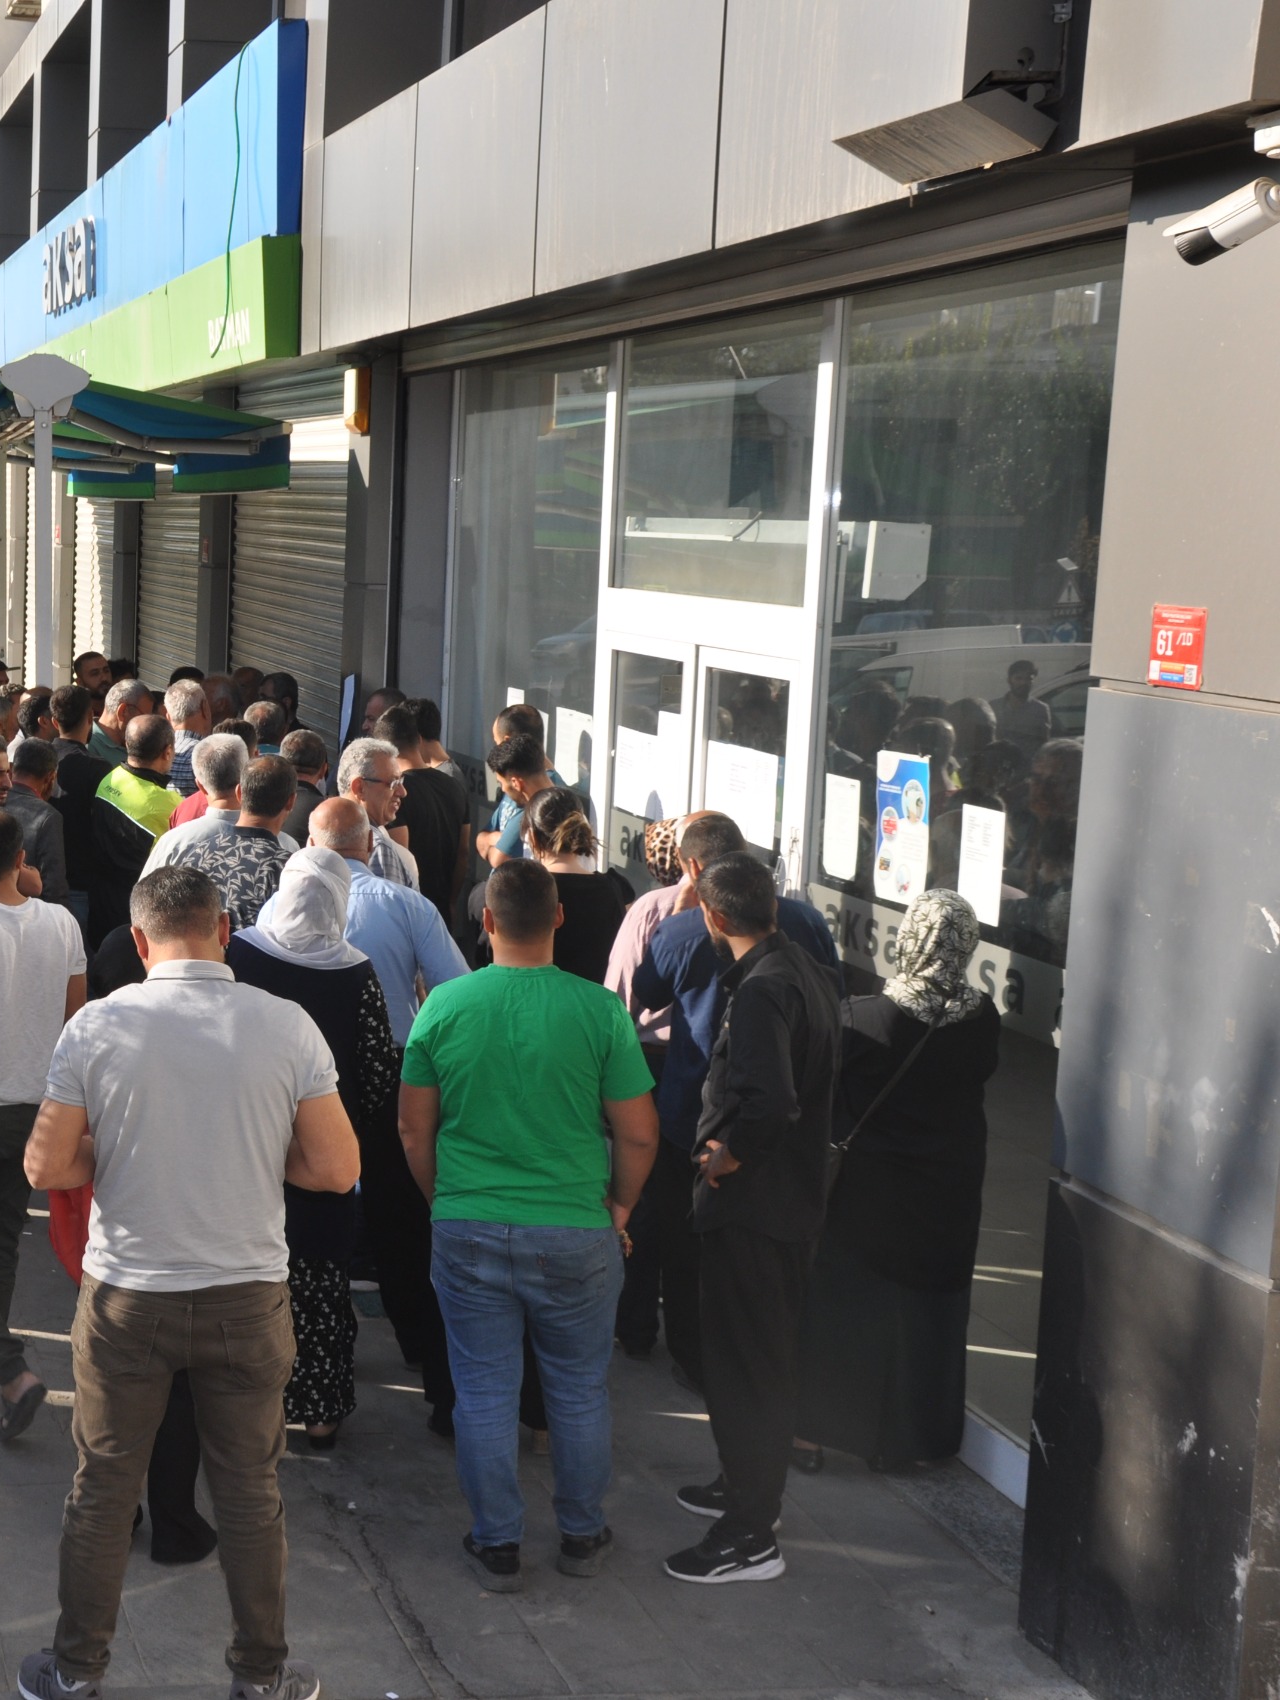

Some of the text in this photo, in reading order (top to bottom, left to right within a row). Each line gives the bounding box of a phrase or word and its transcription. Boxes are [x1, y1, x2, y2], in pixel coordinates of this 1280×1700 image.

[43, 217, 90, 314] aksa
[208, 307, 251, 353] BATMAN
[1156, 629, 1174, 656] 61
